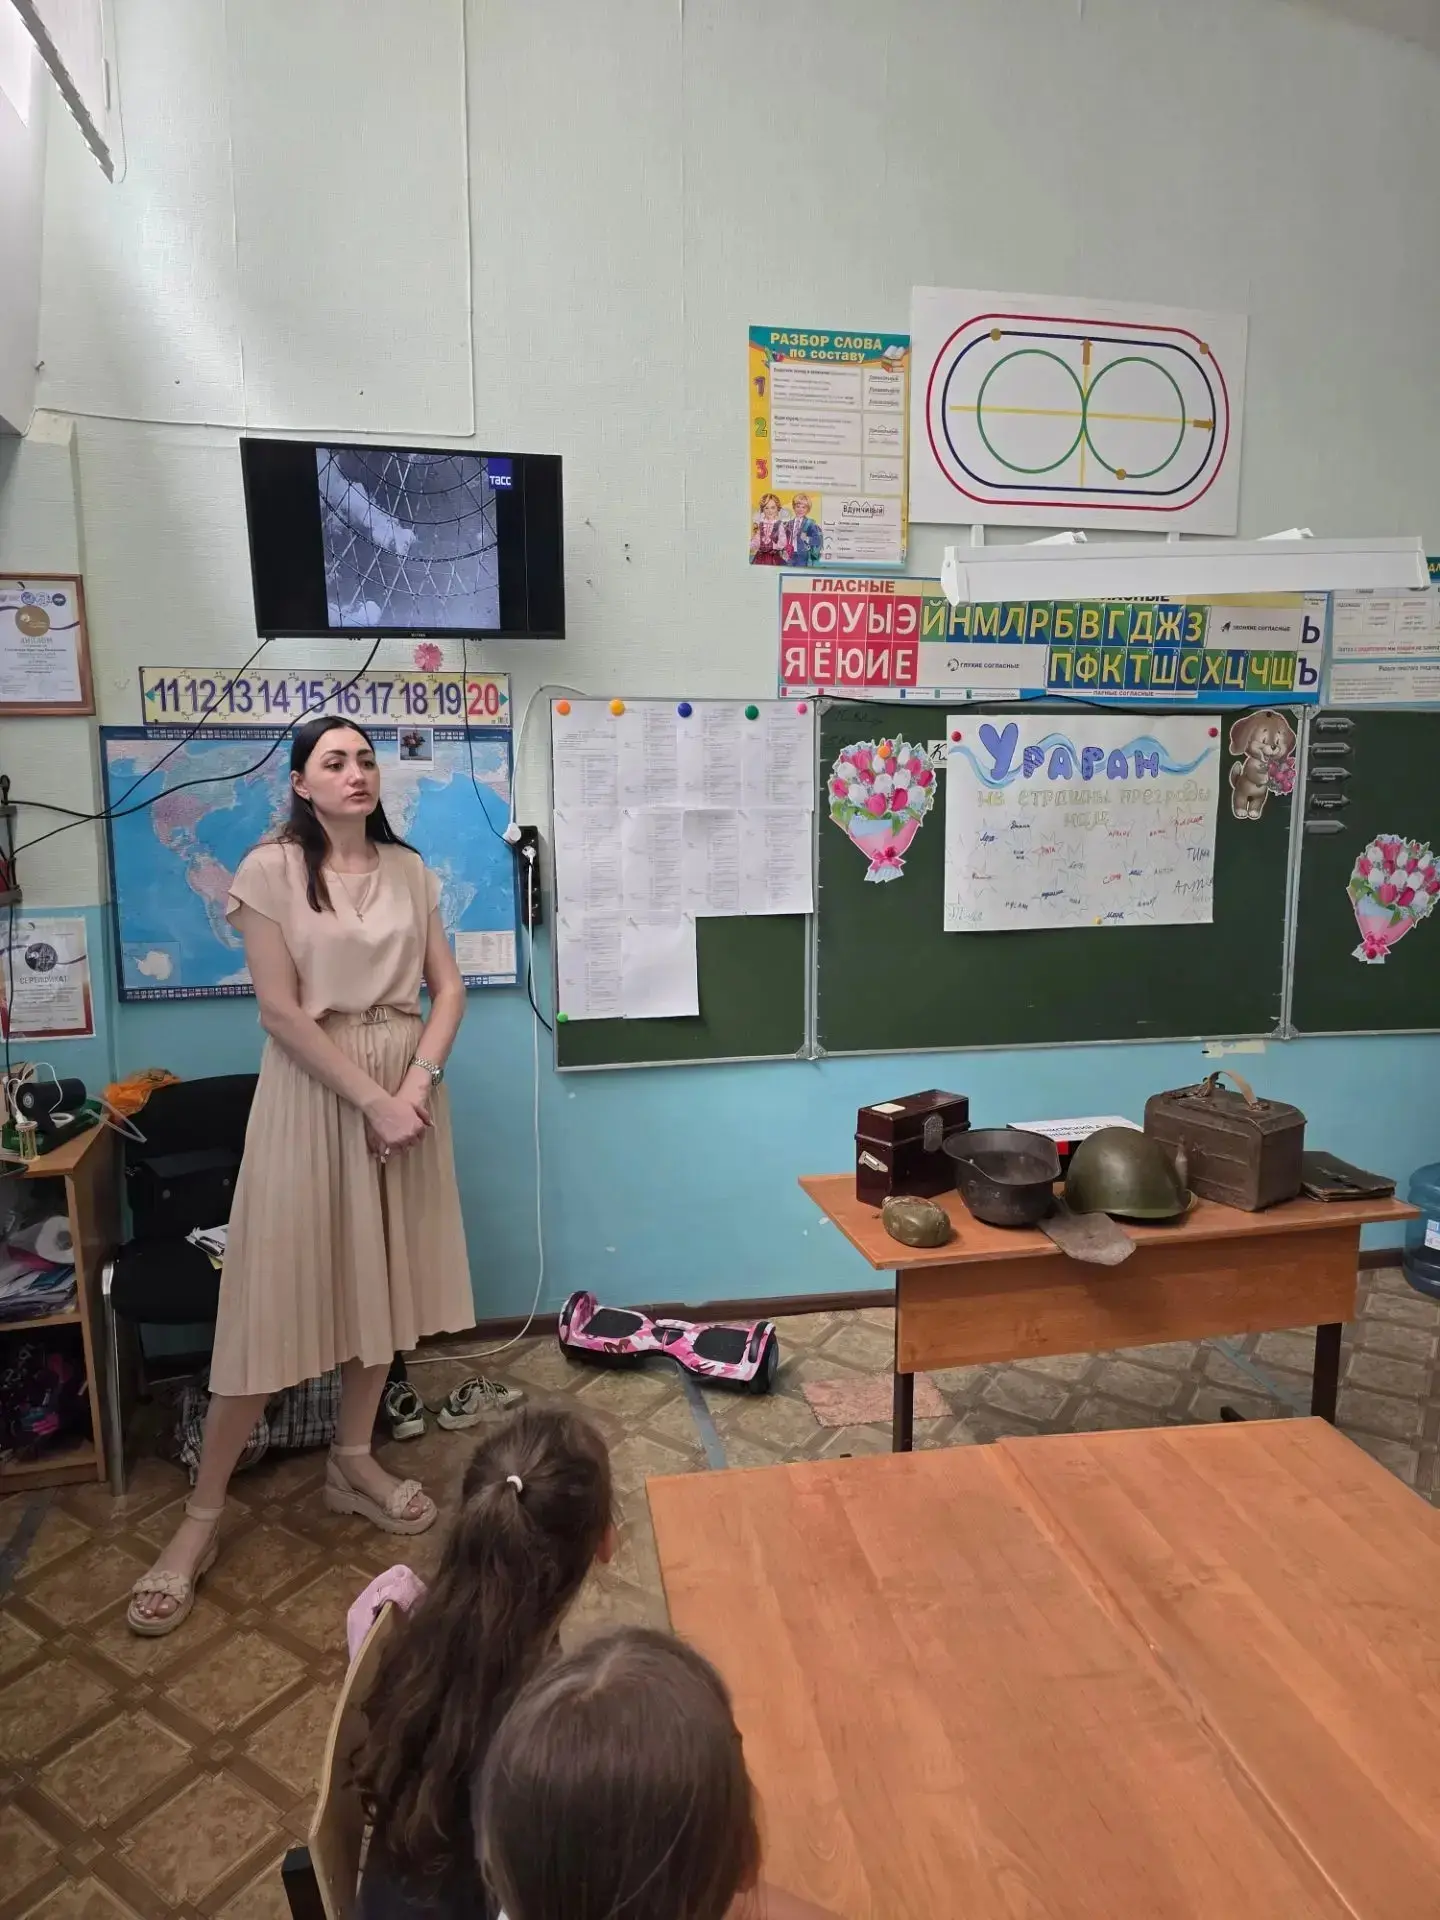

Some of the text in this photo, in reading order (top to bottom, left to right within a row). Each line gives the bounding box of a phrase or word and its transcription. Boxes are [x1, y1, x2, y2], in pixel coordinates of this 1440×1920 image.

[771, 332, 882, 350] РАЗБОР СЛОВА
[790, 349, 865, 363] по составу
[754, 376, 766, 397] 1
[755, 417, 768, 437] 2
[755, 459, 768, 479] 3
[812, 578, 896, 593] ГЛАСНЫЕ
[154, 678, 499, 716] 11 12 13 14 15 16 17 18 19 20
